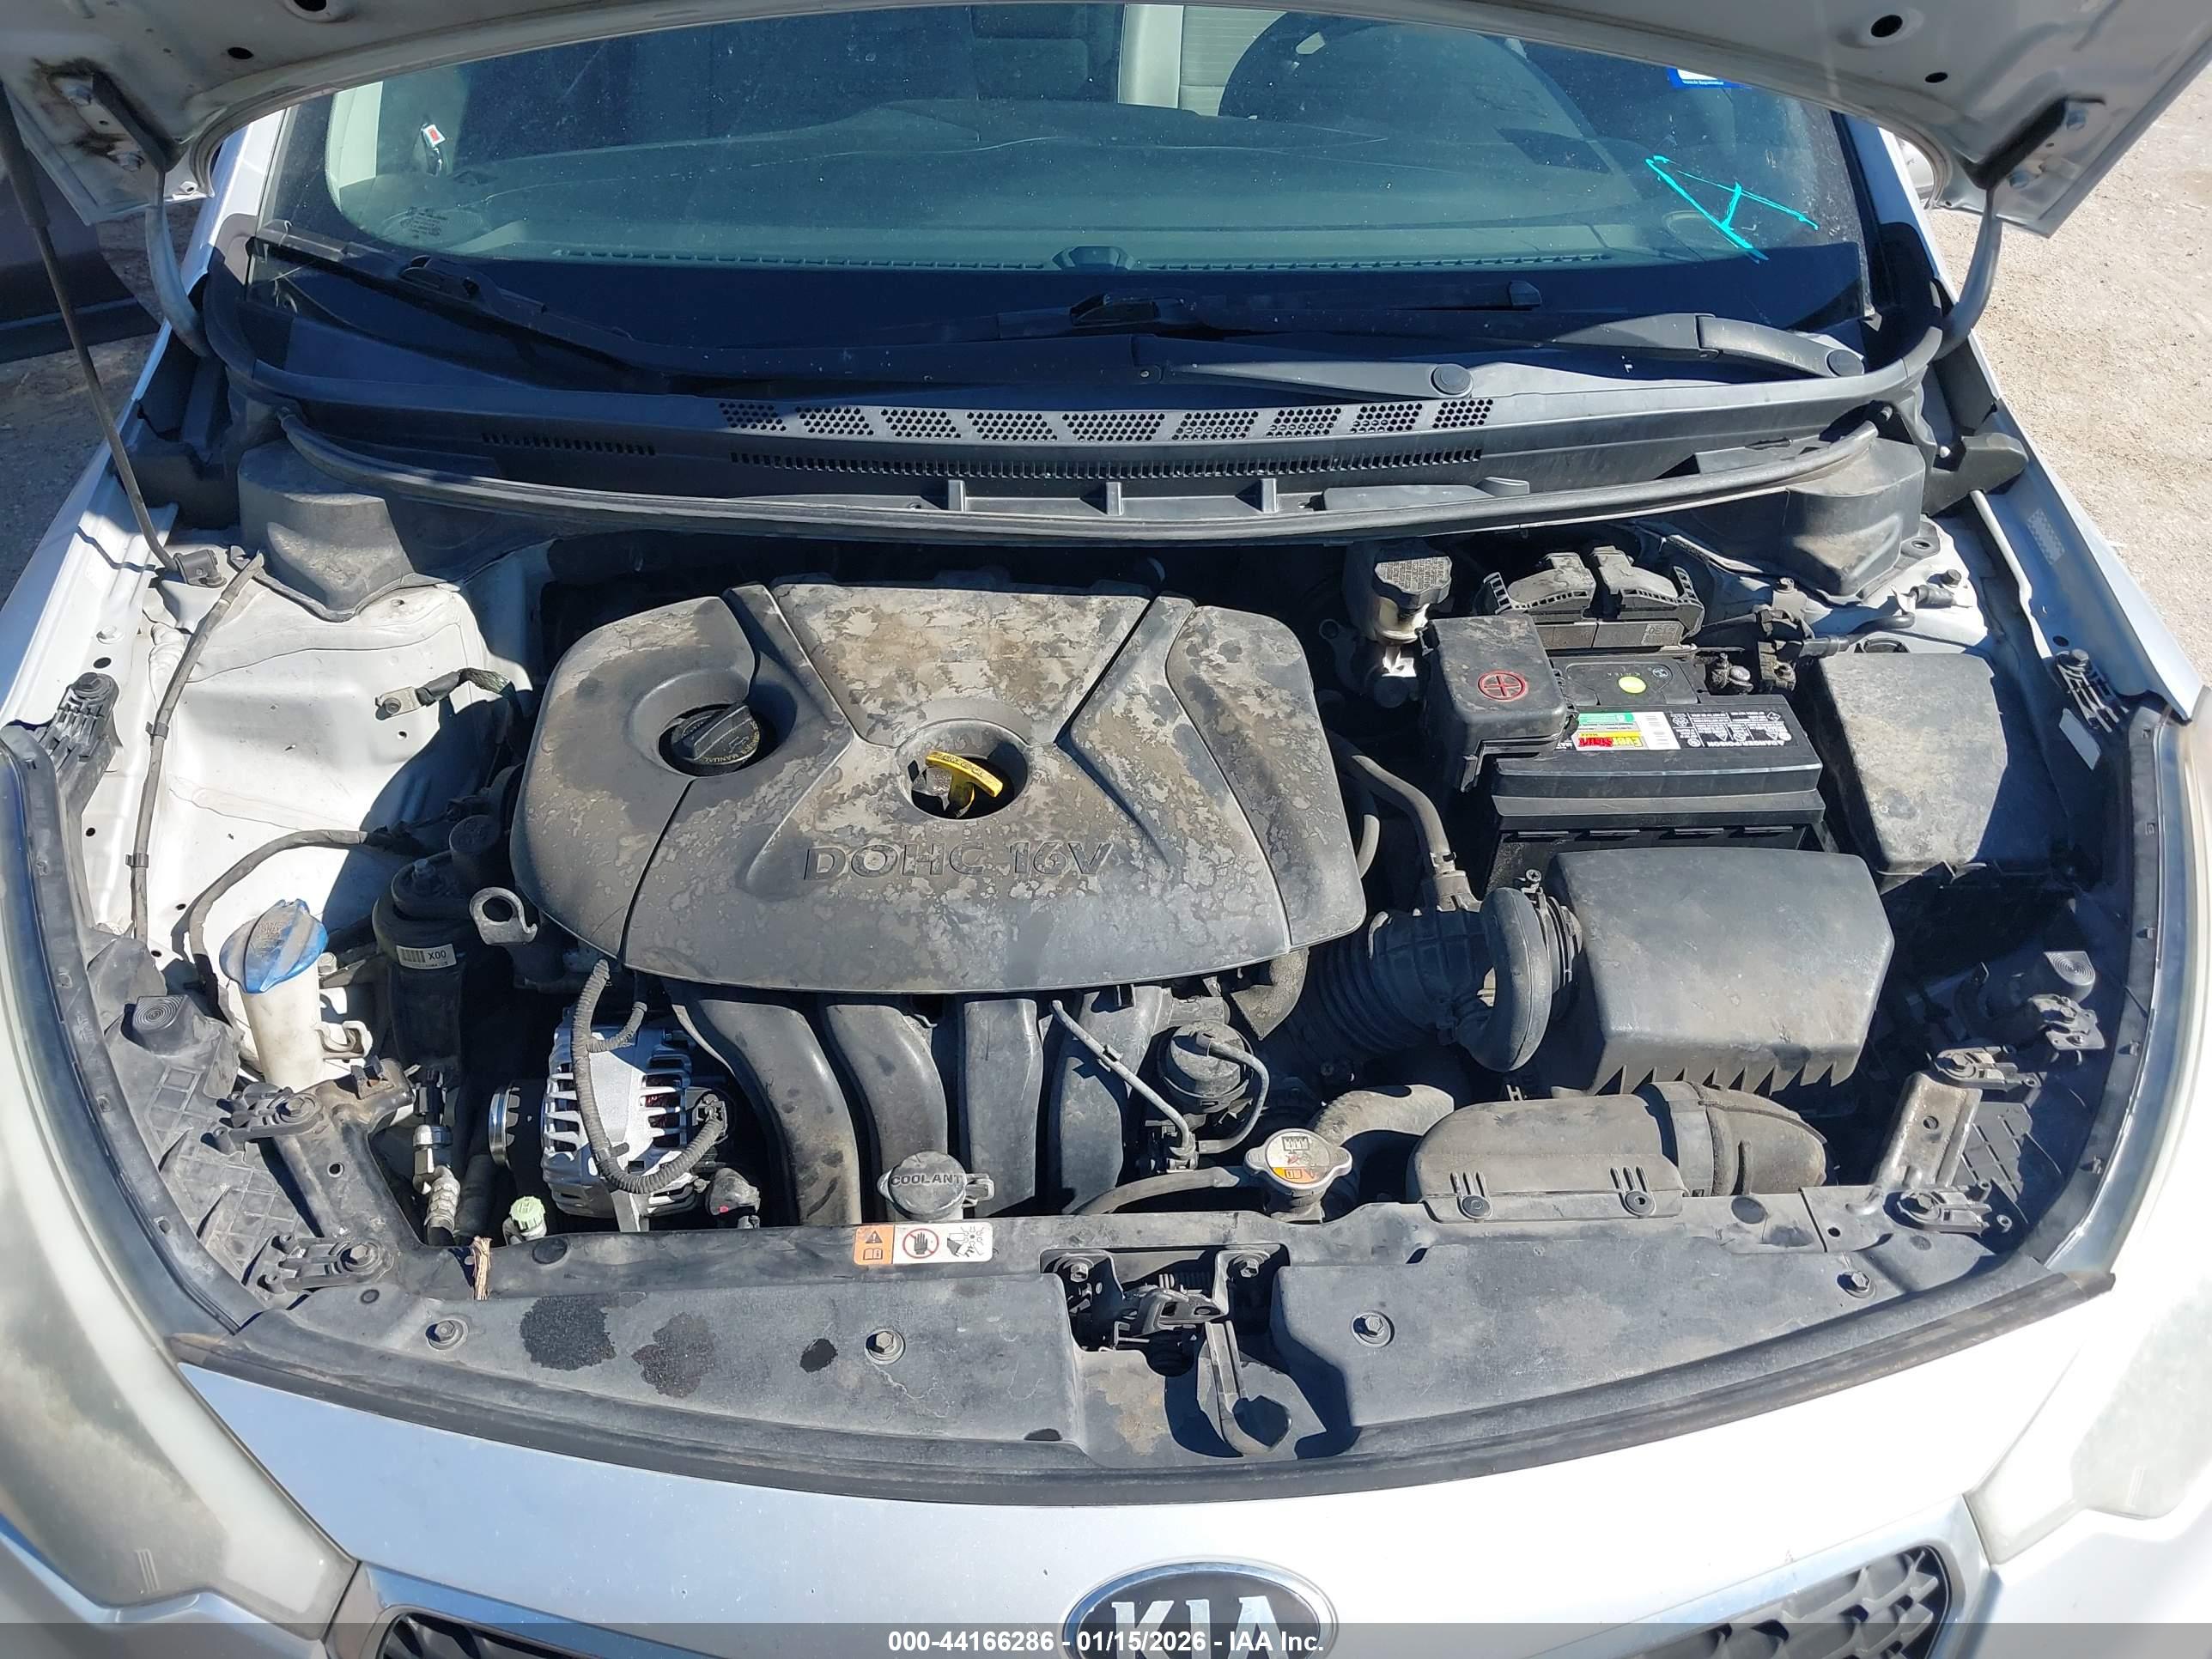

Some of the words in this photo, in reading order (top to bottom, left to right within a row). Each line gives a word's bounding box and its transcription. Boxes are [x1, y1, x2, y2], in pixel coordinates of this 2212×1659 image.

[803, 842, 986, 880] DOHC
[1008, 841, 1115, 876] 16V
[428, 950, 447, 960] X00
[890, 1174, 963, 1186] COOLANT
[1110, 1596, 1292, 1659] KIA
